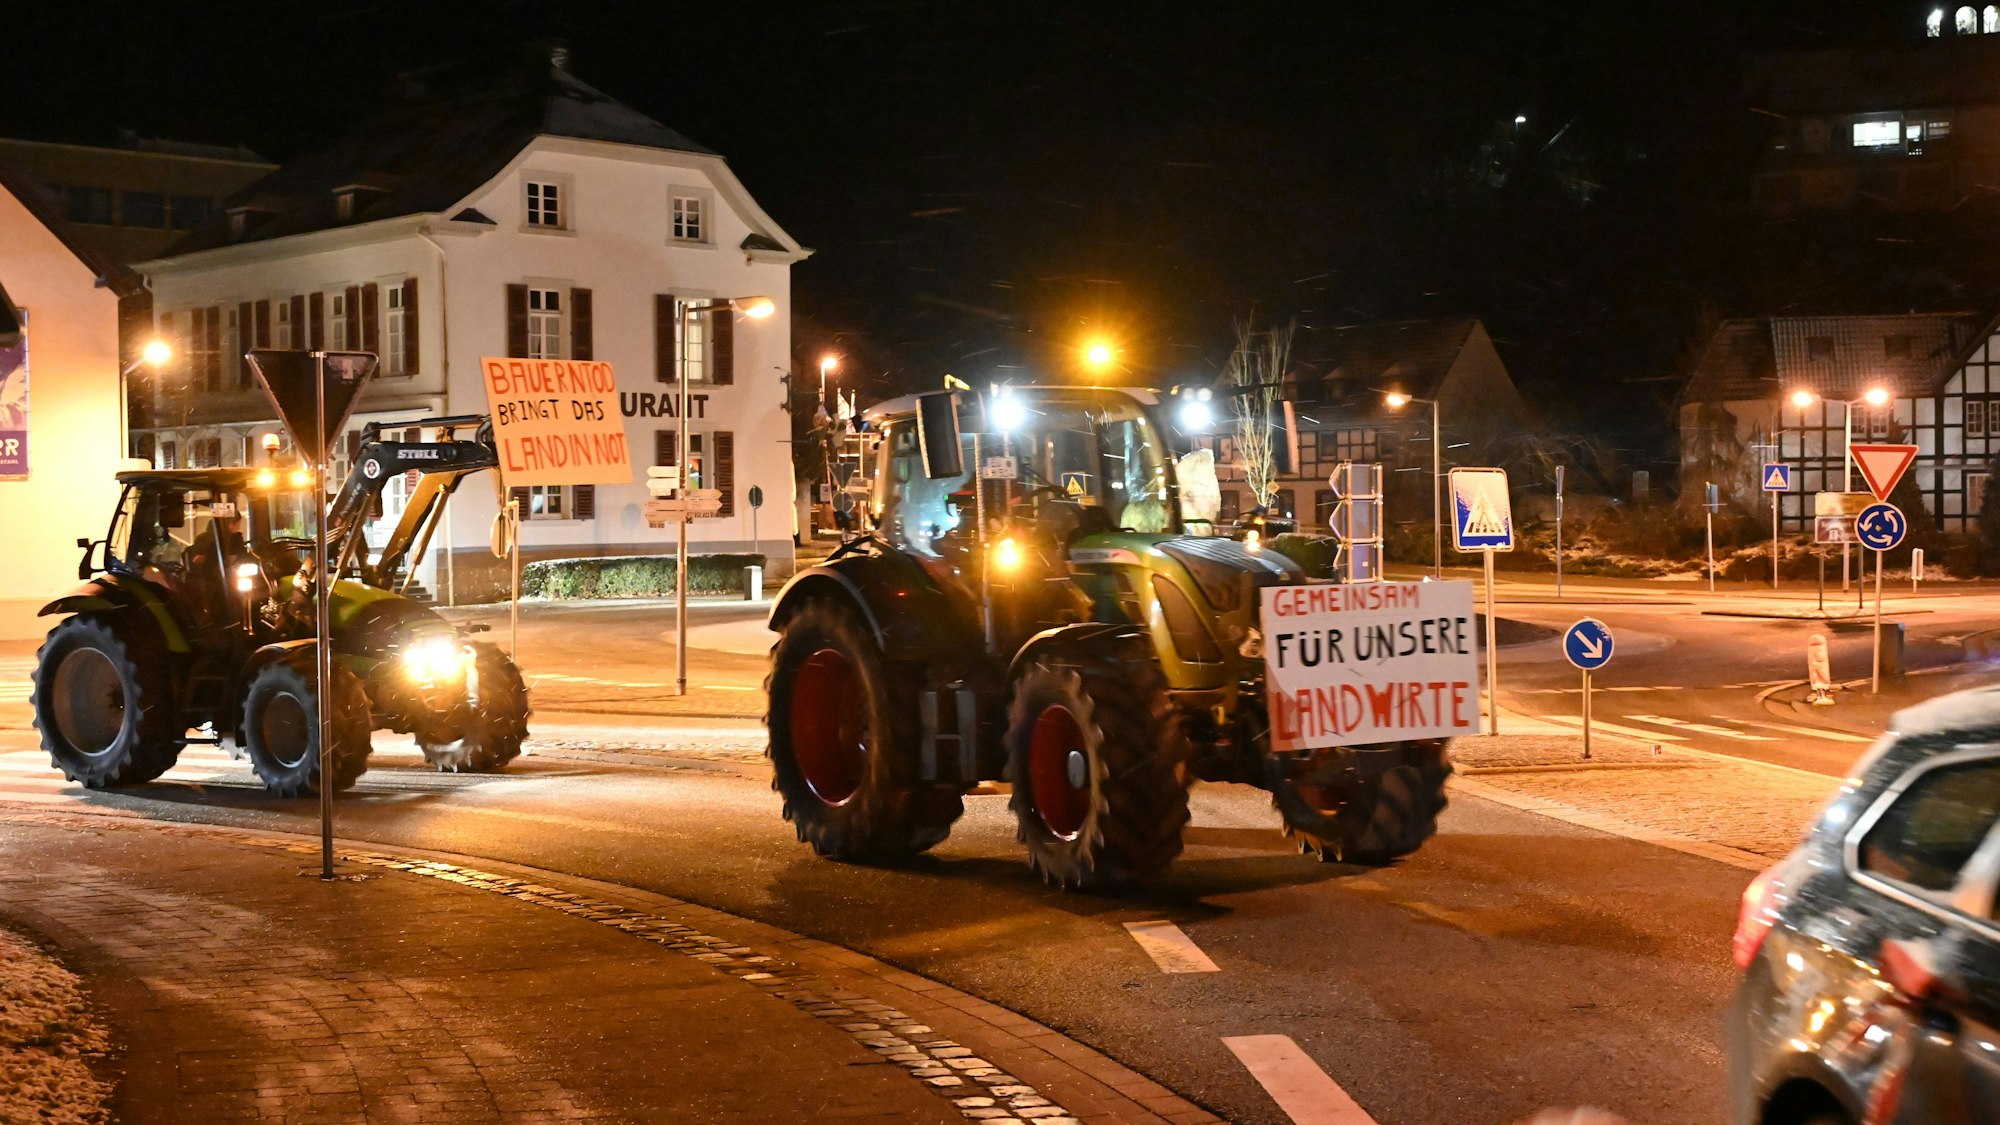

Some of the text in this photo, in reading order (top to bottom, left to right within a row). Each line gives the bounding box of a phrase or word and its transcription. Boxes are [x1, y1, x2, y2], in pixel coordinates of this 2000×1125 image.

[498, 399, 605, 426] BRINGT DAS
[1273, 585, 1420, 617] GEMEINSAM
[1276, 617, 1470, 669] FÜR UNSERE
[1275, 681, 1470, 741] LANDWIRTE
